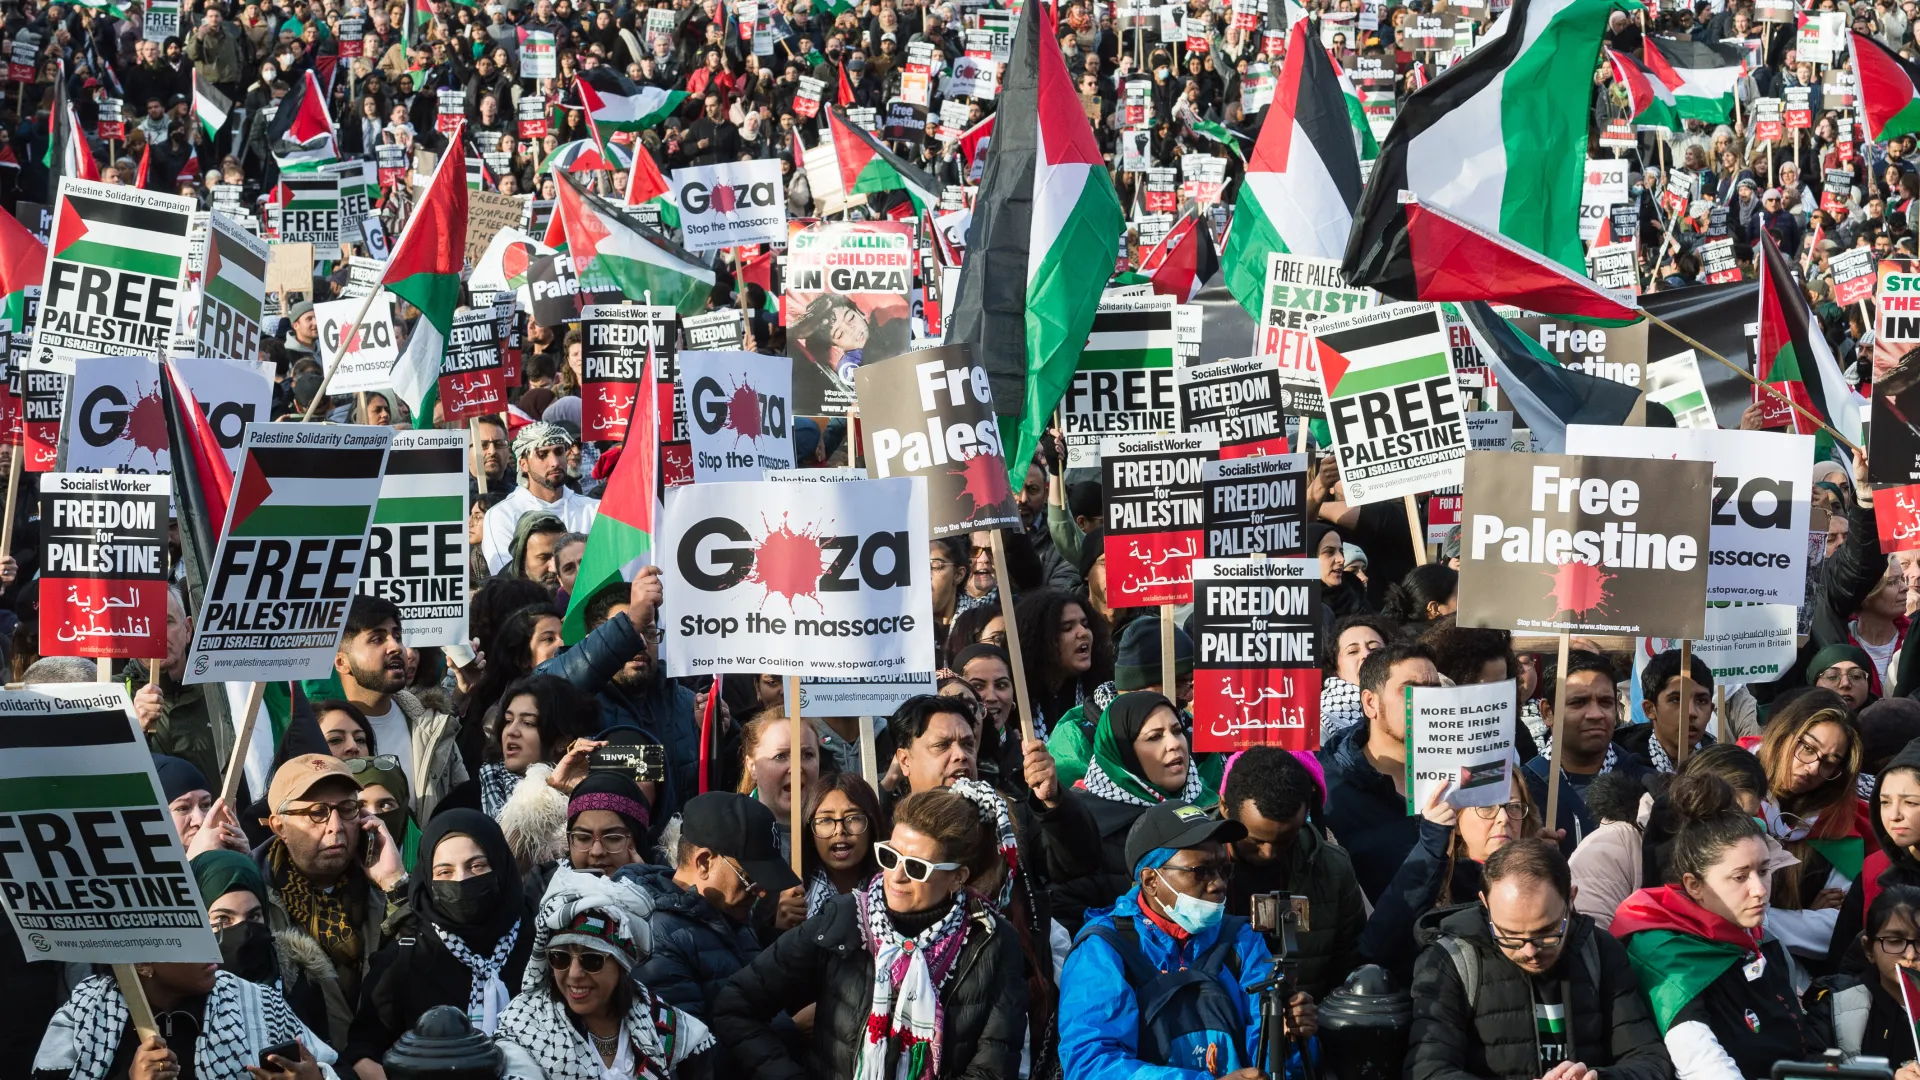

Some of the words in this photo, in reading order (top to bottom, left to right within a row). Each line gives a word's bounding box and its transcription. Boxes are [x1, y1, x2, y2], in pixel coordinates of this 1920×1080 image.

[145, 13, 178, 26] FREE
[1356, 57, 1382, 69] Free
[64, 182, 103, 197] Palestine
[105, 188, 146, 206] Solidarity
[147, 196, 191, 214] Campaign
[212, 214, 230, 233] Palestine
[282, 210, 338, 232] FREE
[687, 221, 710, 236] Stop
[711, 220, 726, 231] the
[728, 217, 779, 229] massacre
[282, 231, 339, 243] PALESTINE
[841, 235, 905, 249] KILLING
[826, 252, 908, 266] CHILDREN
[1833, 253, 1868, 273] FREEDOM
[794, 269, 822, 289] IN
[831, 268, 905, 291] GAZA
[1274, 260, 1304, 284] FREE
[1834, 264, 1873, 284] PALESTINE
[46, 260, 178, 327] FREE
[1097, 302, 1132, 312] Solidarity
[1134, 301, 1172, 311] Campaign
[199, 293, 259, 359] FREE
[1312, 319, 1350, 334] Palestine
[1352, 309, 1391, 327] Solidarity
[1393, 301, 1435, 317] Campaign
[41, 308, 171, 350] PALESTINE
[690, 322, 737, 344] FREEDOM
[1539, 323, 1607, 353] Free
[40, 333, 62, 345] END
[63, 336, 102, 353] ISRAELI
[620, 346, 634, 357] for
[451, 374, 490, 393] الحرية
[1065, 369, 1175, 413] FREE
[1188, 375, 1272, 411] FREEDOM
[450, 389, 499, 413] لفلسطين
[1225, 404, 1241, 418] for
[1330, 376, 1460, 446] FREE
[1066, 410, 1175, 433] PALESTINE
[250, 431, 294, 444] Palestine
[296, 432, 338, 447] Solidarity
[340, 433, 388, 448] Campaign
[417, 434, 464, 449] Campaign
[1339, 422, 1465, 468] PALESTINE
[698, 451, 723, 473] Stop
[725, 451, 752, 468] the
[758, 452, 790, 470] massacre
[1346, 468, 1367, 481] END
[1368, 460, 1406, 476] ISRAELI
[1407, 447, 1465, 469] OCCUPATION
[1154, 486, 1170, 499] for
[1213, 479, 1296, 514] FREEDOM
[1531, 465, 1640, 517] Free
[53, 499, 156, 530] FREEDOM
[1250, 511, 1265, 524] for
[96, 529, 114, 543] for
[933, 525, 949, 534] Stop
[949, 523, 960, 531] the
[960, 520, 973, 529] War
[1209, 520, 1301, 557] PALESTINE
[1471, 514, 1698, 571] Palestine
[47, 543, 161, 574] PALESTINE
[1128, 537, 1197, 566] الحرية
[211, 538, 363, 600] FREE
[66, 585, 140, 614] الحرية
[1206, 586, 1309, 616] FREEDOM
[202, 600, 346, 631] PALESTINE
[680, 614, 739, 638] Stop
[745, 612, 787, 635] the
[794, 614, 915, 637] massacre
[1251, 616, 1268, 631] for
[57, 614, 151, 642] لفلسطين
[1579, 622, 1640, 632] www.stopwar.org.uk
[199, 635, 223, 650] END
[224, 634, 268, 649] ISRAELI
[269, 631, 336, 648] OCCUPATION
[1201, 632, 1315, 662] PALESTINE
[1691, 643, 1732, 652] Palestinian
[1734, 642, 1757, 651] Forum
[1758, 640, 1766, 648] in
[1767, 638, 1792, 648] Britain
[214, 656, 311, 669] www.palestinecampaign.org
[692, 657, 715, 668] Stop
[717, 656, 734, 666] the
[736, 656, 756, 666] War
[758, 656, 804, 668] Coalition
[810, 656, 906, 669] www.stopwar.org.uk
[1220, 676, 1294, 706] الحرية
[54, 694, 122, 711] Campaign
[1420, 707, 1456, 716] MORE
[1460, 701, 1508, 715] BLACKS
[1210, 706, 1305, 735] لفلسطين
[1428, 720, 1464, 729] MORE
[1467, 716, 1500, 728] IRISH
[1428, 733, 1464, 742] MORE
[1467, 729, 1500, 742] JEWS
[600, 753, 635, 761] CHANEL
[1417, 746, 1453, 755] MORE
[1456, 739, 1510, 755] MUSLIMS
[1416, 771, 1457, 782] MORE
[1, 877, 195, 911] PALESTINE
[19, 914, 49, 929] END
[50, 912, 108, 929] ISRAELI
[109, 911, 201, 929] OCCUPATION
[54, 937, 182, 951] www.palestinecampaign.org
